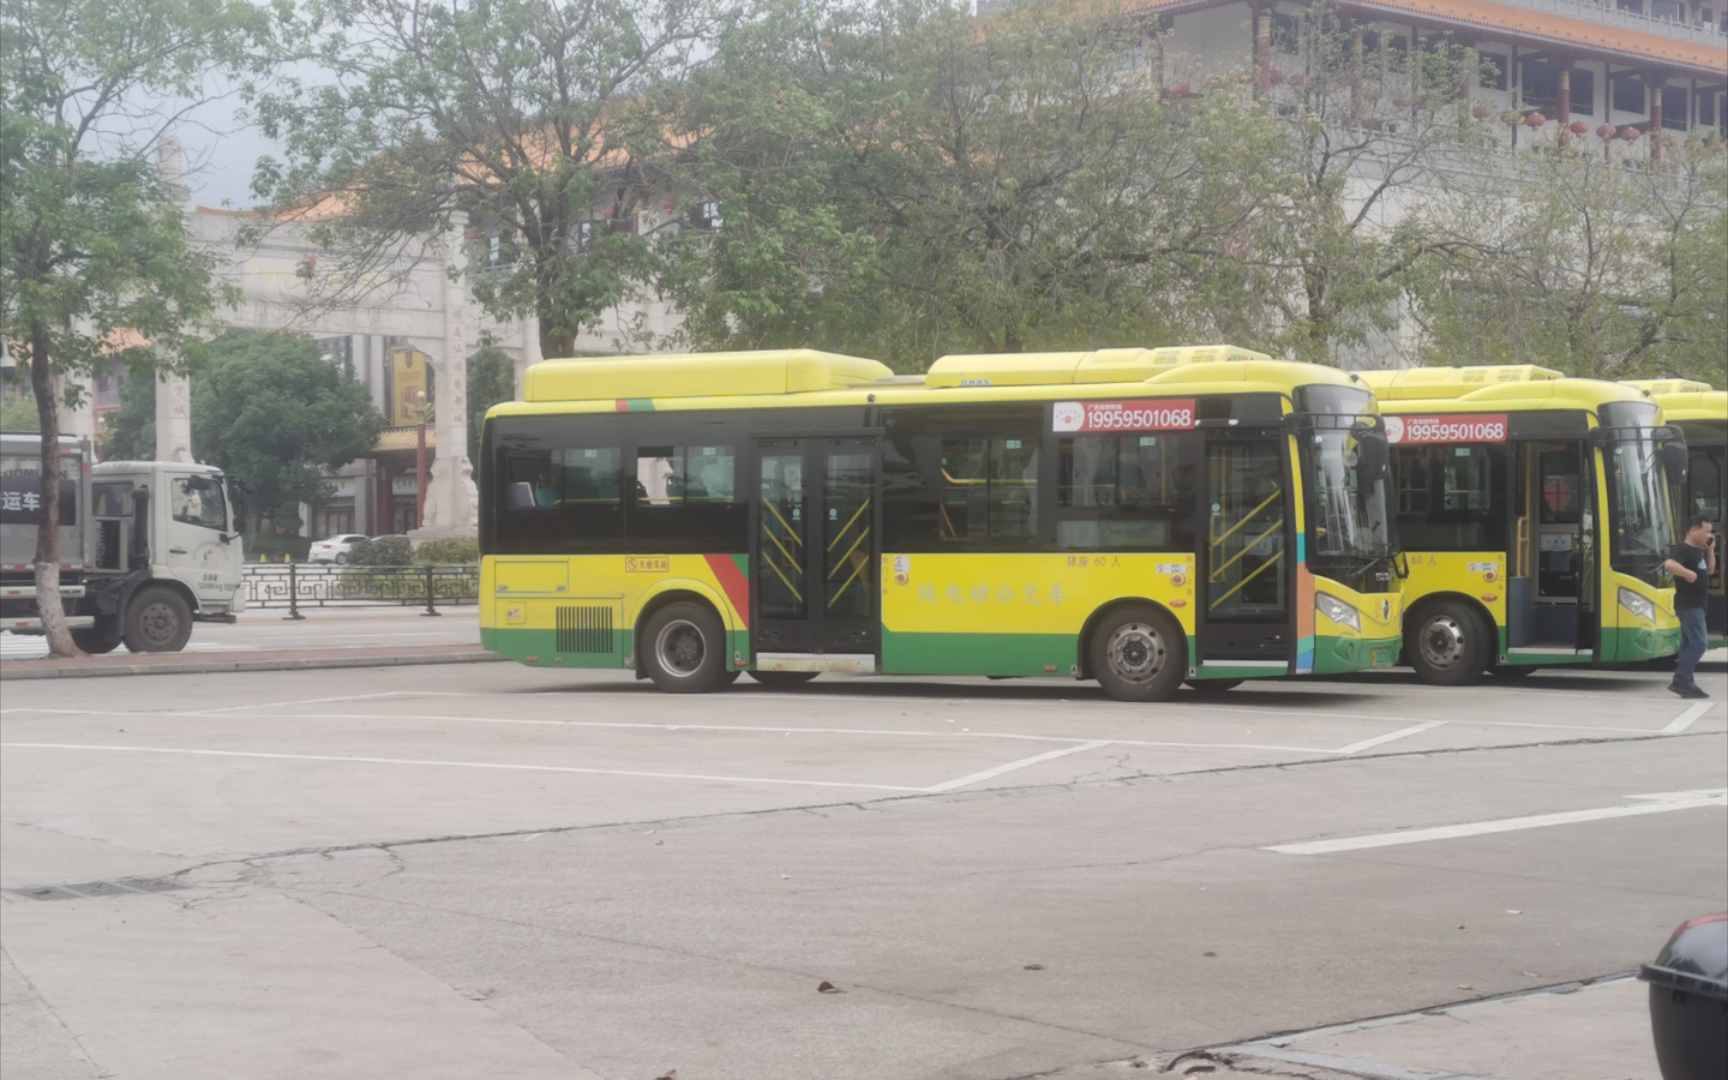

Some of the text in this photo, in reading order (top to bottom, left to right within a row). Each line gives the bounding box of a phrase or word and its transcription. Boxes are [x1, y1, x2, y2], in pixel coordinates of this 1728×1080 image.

[1087, 409, 1191, 429] 19959501068
[1407, 423, 1504, 441] 19959501068
[1067, 555, 1121, 568] 限座 60 人
[1411, 555, 1423, 564] 60
[1427, 554, 1437, 565] 人
[918, 582, 1068, 607] 纯电动公交车
